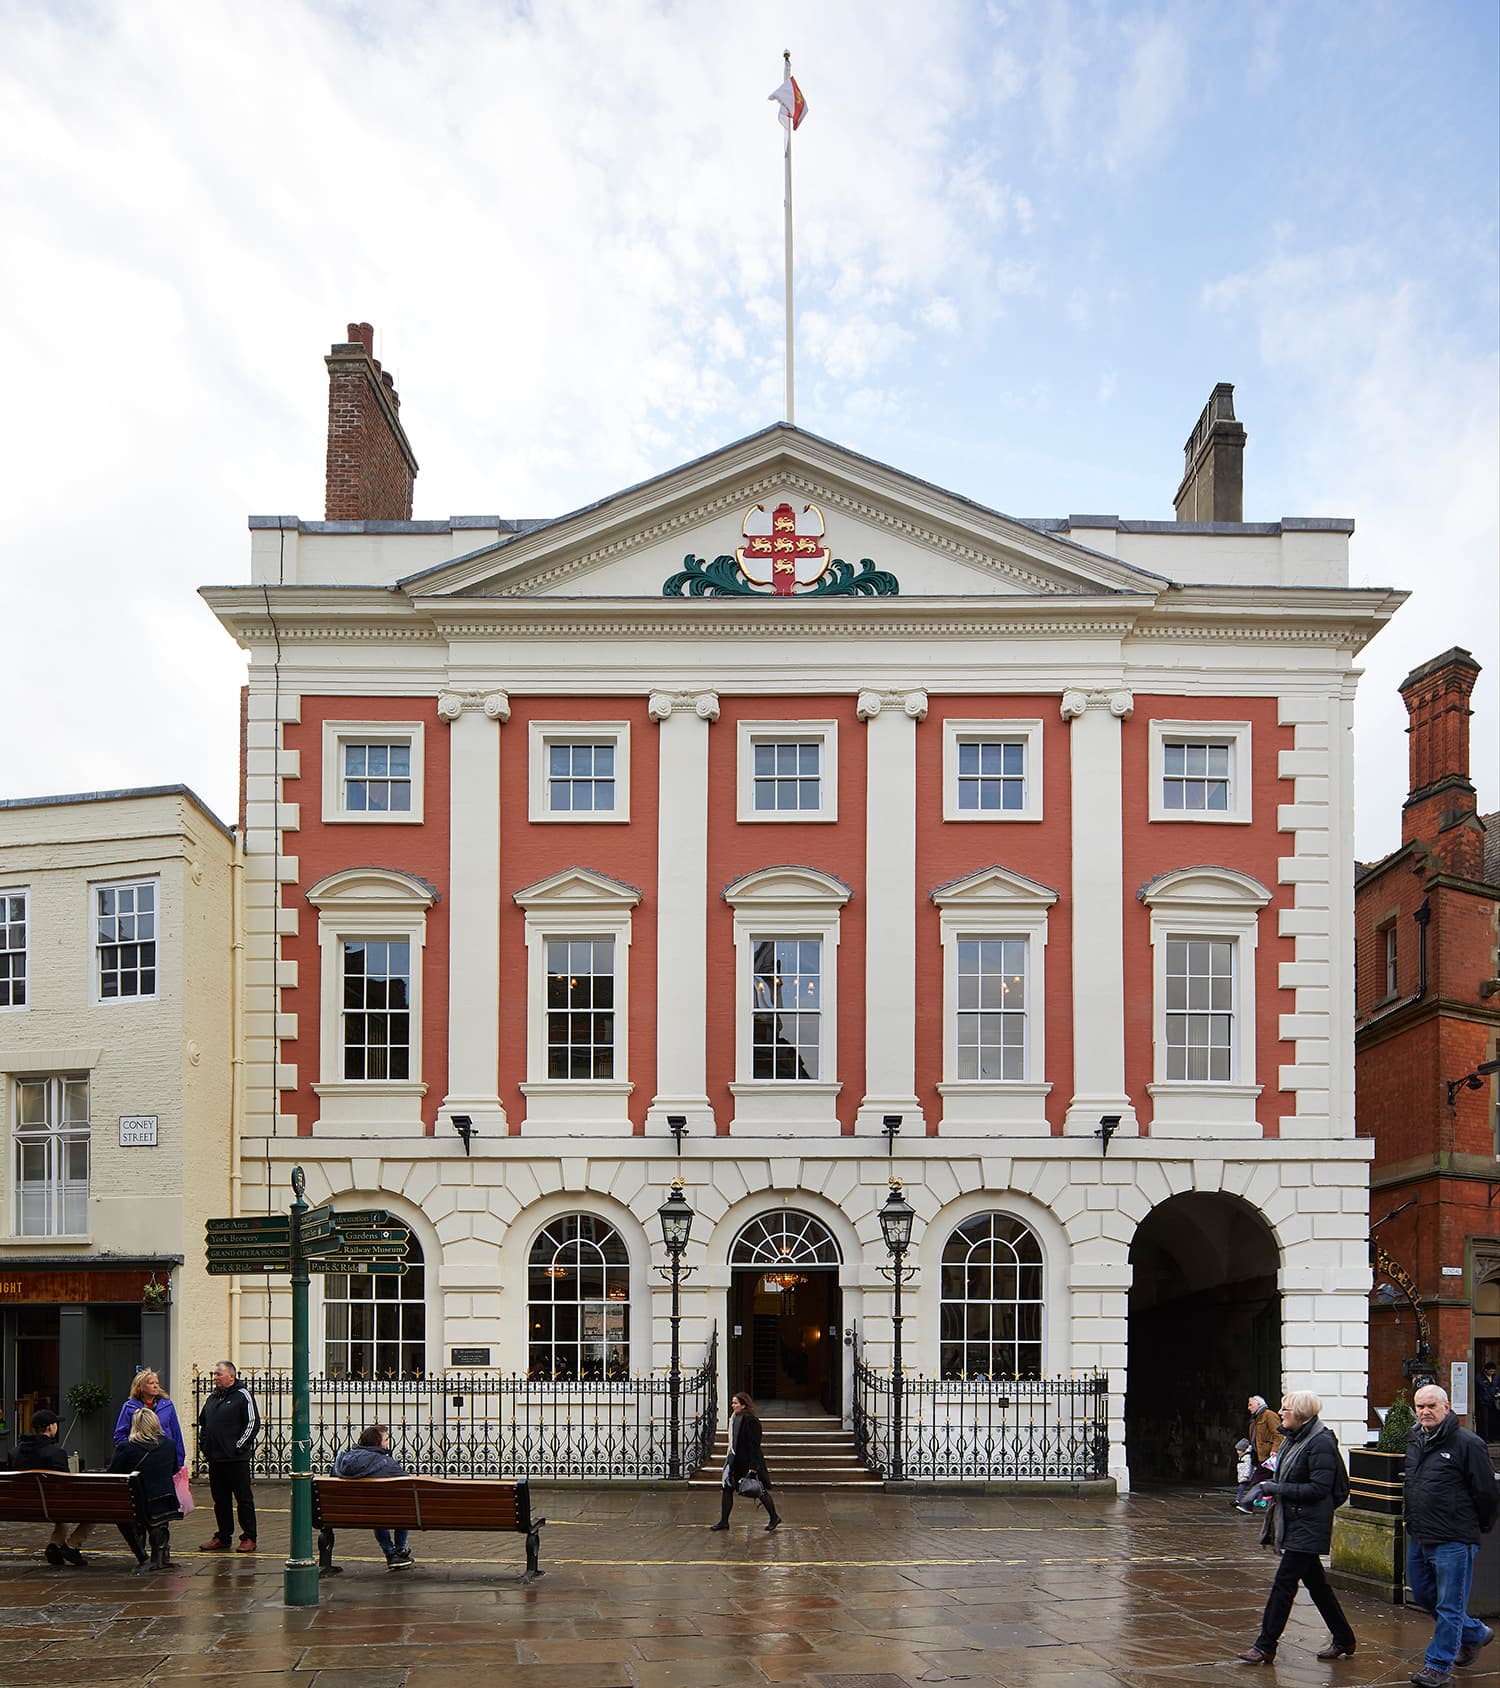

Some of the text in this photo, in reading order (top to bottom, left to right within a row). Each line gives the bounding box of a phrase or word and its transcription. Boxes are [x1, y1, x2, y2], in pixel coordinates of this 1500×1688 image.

[122, 1120, 154, 1129] CONEY
[122, 1132, 154, 1142] STREET
[335, 1215, 369, 1223] nformation
[231, 1221, 249, 1229] Area
[210, 1234, 258, 1243] York Brewery
[210, 1249, 236, 1257] GRAND
[343, 1246, 370, 1255] Railway
[211, 1264, 228, 1272] Park
[235, 1263, 252, 1271] Ride
[311, 1263, 331, 1272] Park
[340, 1263, 359, 1271] Ride
